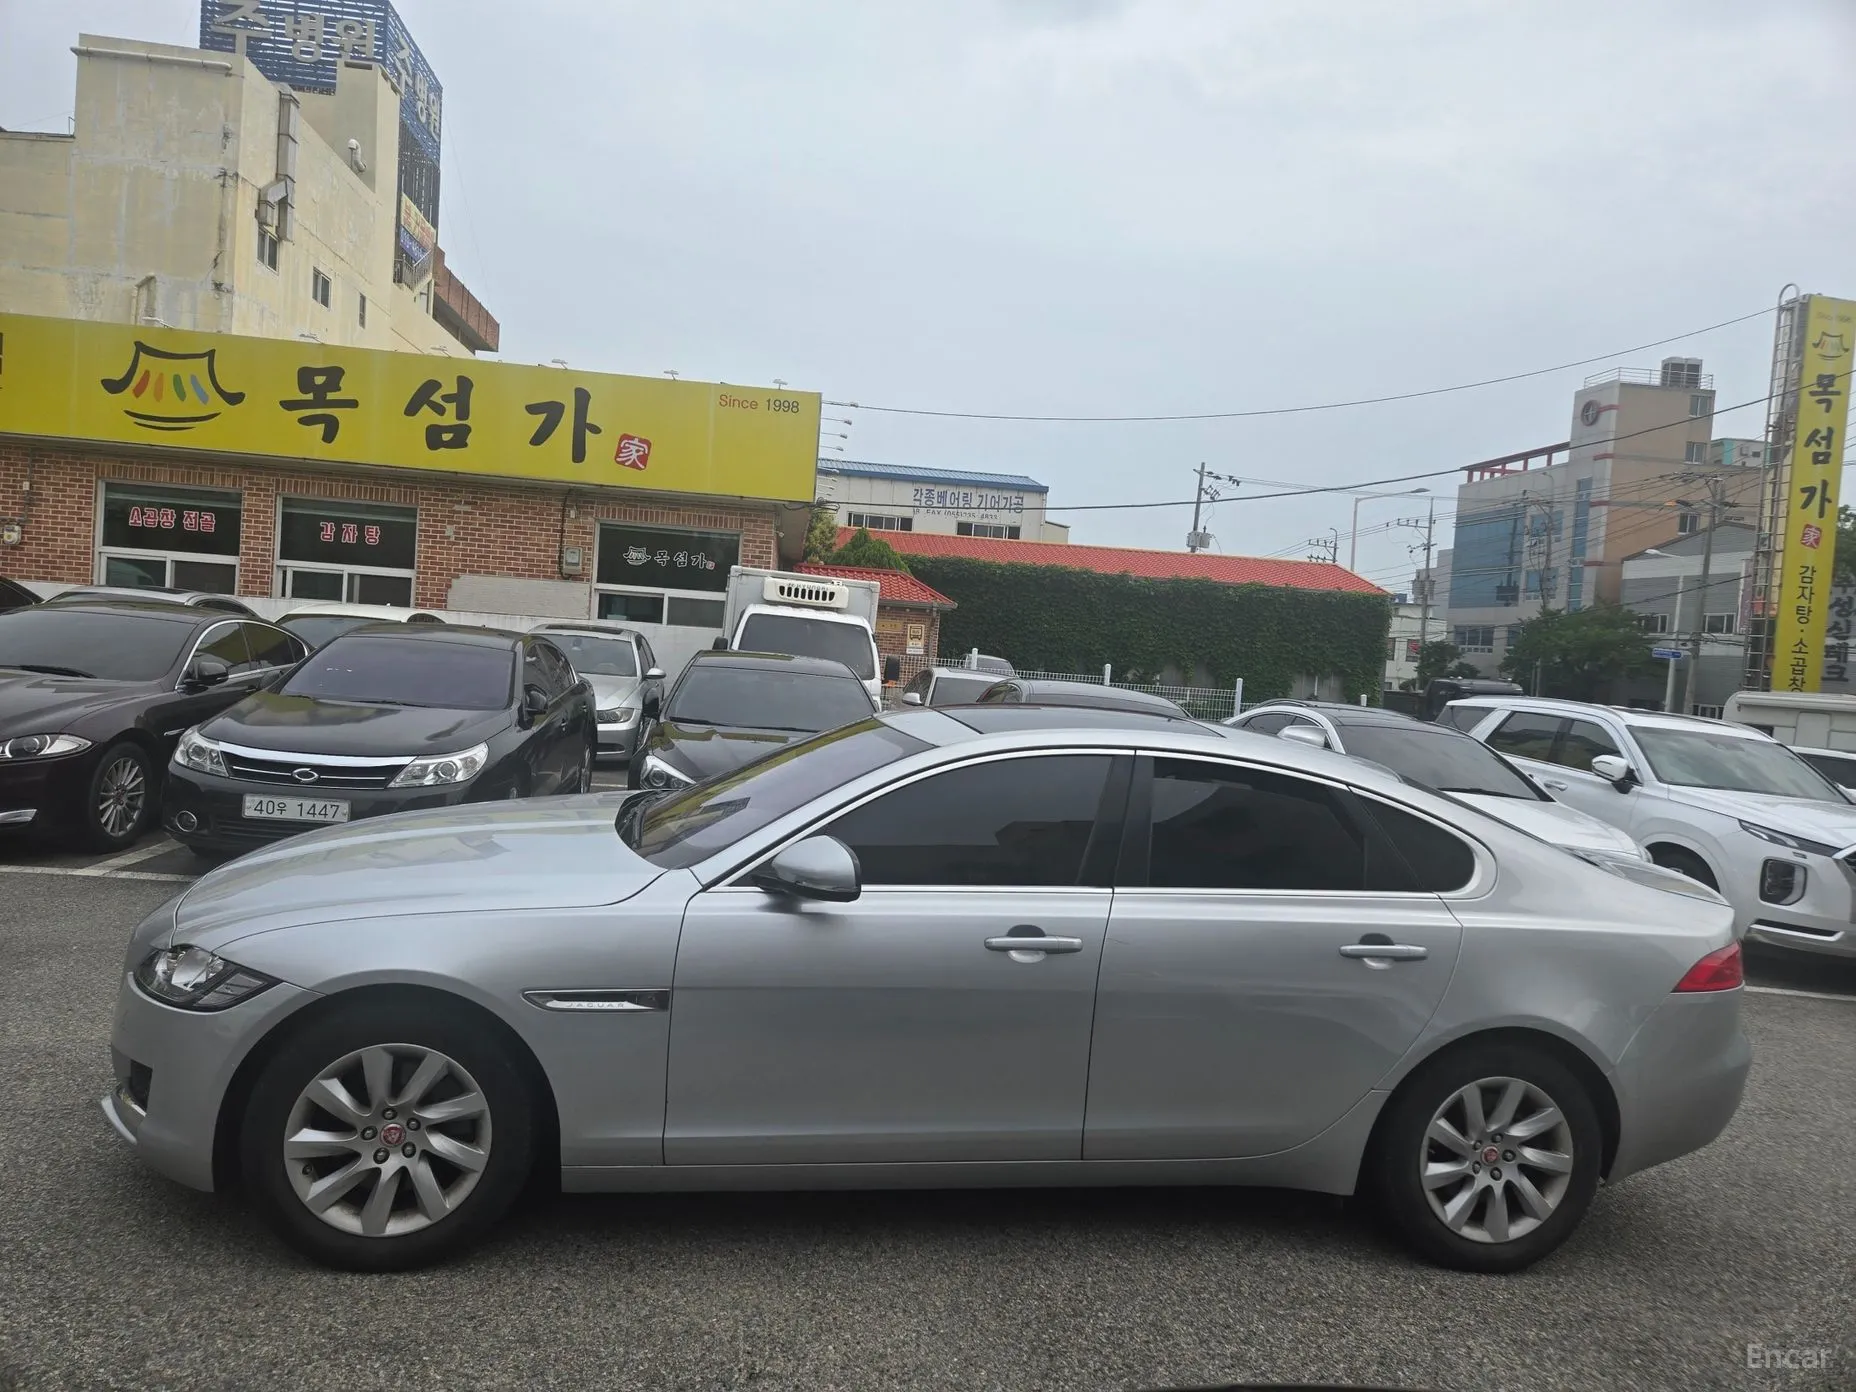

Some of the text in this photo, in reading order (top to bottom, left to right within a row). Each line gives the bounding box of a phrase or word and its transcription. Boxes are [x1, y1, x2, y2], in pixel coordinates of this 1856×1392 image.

[719, 394, 800, 414] Since 1998
[617, 436, 650, 469] 家
[977, 494, 1024, 515] 기어가공
[128, 506, 217, 533] 소곱창 전골
[253, 800, 340, 819] 40우 1447
